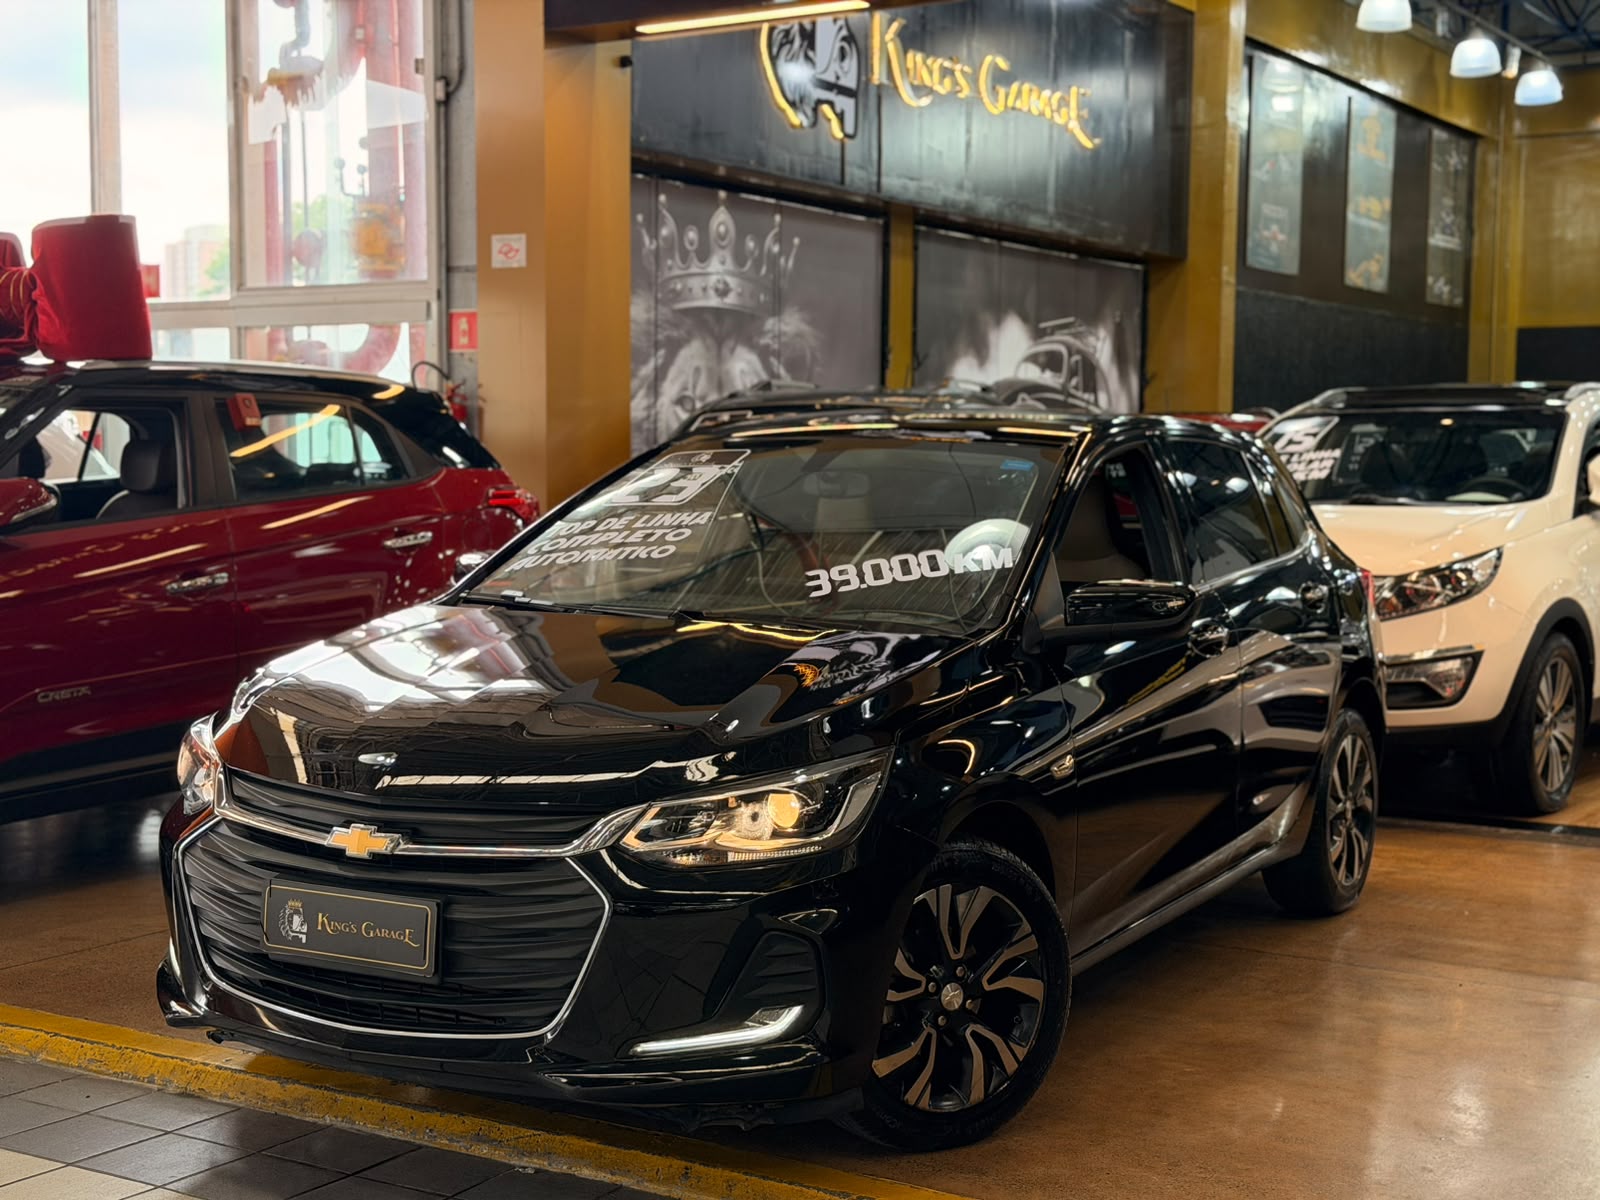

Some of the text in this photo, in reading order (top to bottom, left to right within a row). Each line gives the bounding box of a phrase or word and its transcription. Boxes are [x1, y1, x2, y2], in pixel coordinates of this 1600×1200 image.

[548, 512, 711, 537] TOP DE LINHA
[527, 528, 693, 554] COMPLETO
[804, 547, 1013, 597] 39.000 KM
[361, 921, 420, 948] GARAGE
